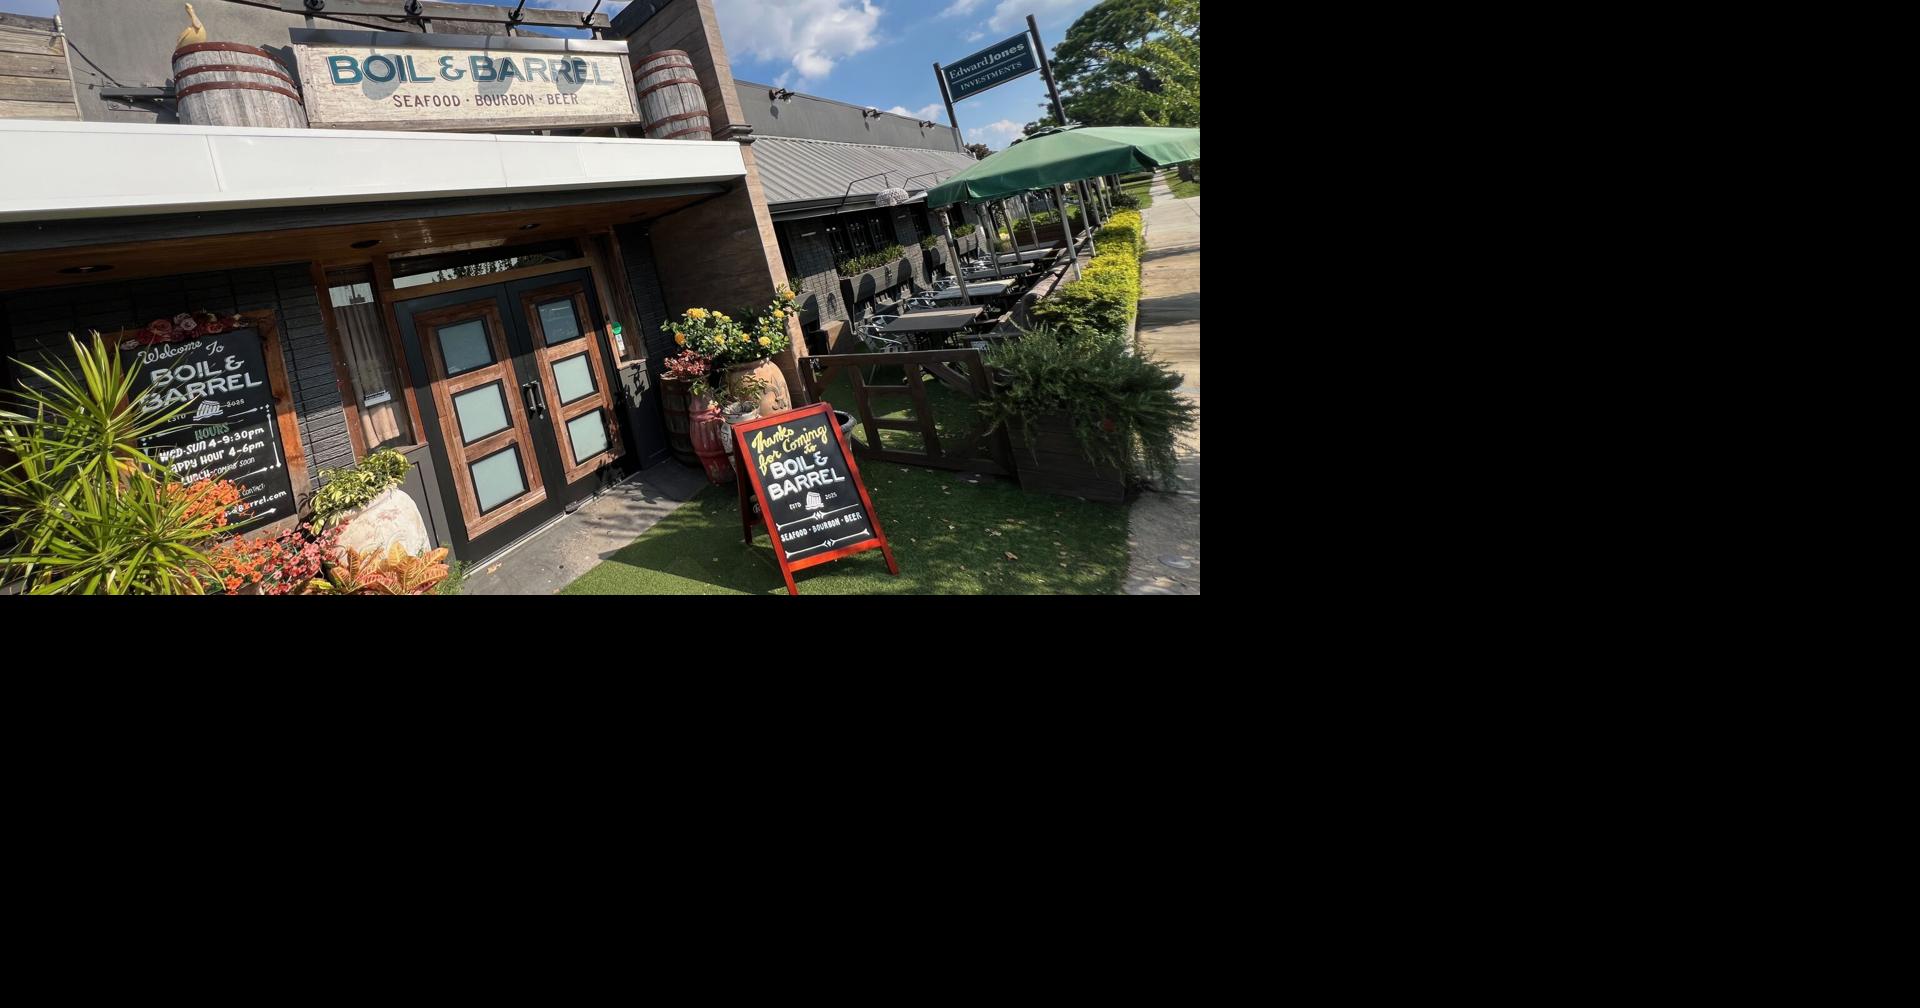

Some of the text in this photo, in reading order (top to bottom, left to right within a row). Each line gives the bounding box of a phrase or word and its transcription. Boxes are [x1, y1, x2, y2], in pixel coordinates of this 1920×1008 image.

[326, 55, 615, 86] BOIL & BARREL
[960, 61, 1023, 91] INVESTMENTS
[393, 94, 579, 108] SEAFOOD BOURBON BEER
[137, 340, 225, 365] Welcome To
[150, 355, 245, 388] BOIL &
[140, 372, 263, 413] BARREL
[194, 422, 230, 441] HOURS
[208, 426, 265, 448] 4-9:30pm
[751, 425, 795, 454] Thanks
[228, 439, 265, 457] 4-6pm
[758, 425, 828, 477] for Coming
[803, 443, 817, 454] to
[769, 450, 829, 480] BOIL &
[767, 467, 846, 501] BARREL
[780, 511, 863, 542] SEAFOOD BOURBON BEER
